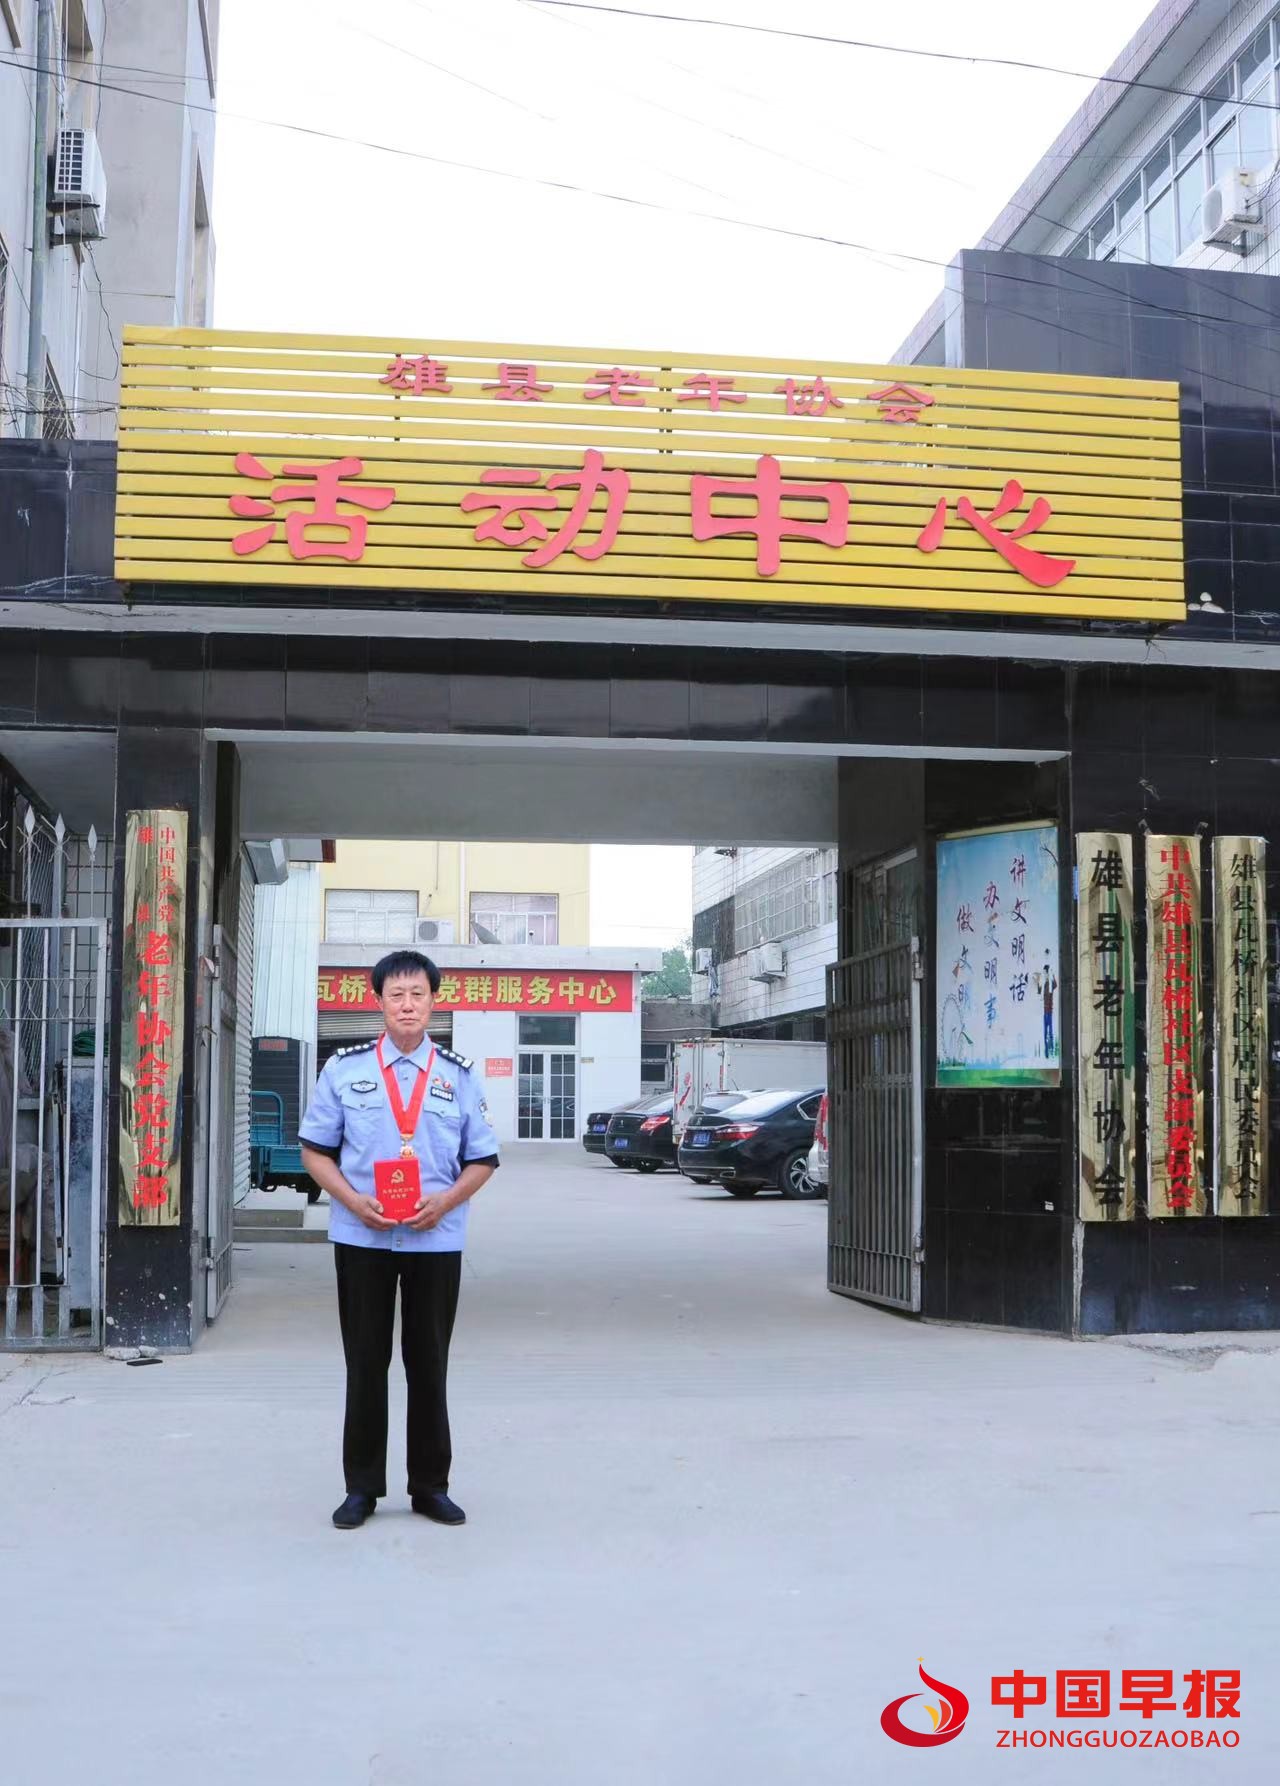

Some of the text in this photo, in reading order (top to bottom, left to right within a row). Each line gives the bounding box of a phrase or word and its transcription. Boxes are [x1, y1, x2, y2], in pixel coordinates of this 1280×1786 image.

[379, 354, 936, 423] 雄县老年协会
[228, 448, 1077, 588] 活动中心
[159, 827, 176, 922] 中国共产党
[1008, 854, 1030, 1002] 讲文明话
[318, 973, 617, 1005] 瓦桥党群服务中心
[983, 881, 1000, 1029] 办文明事
[1091, 849, 1126, 1204] 雄县老年协会
[133, 929, 172, 1210] 老年协会党支部
